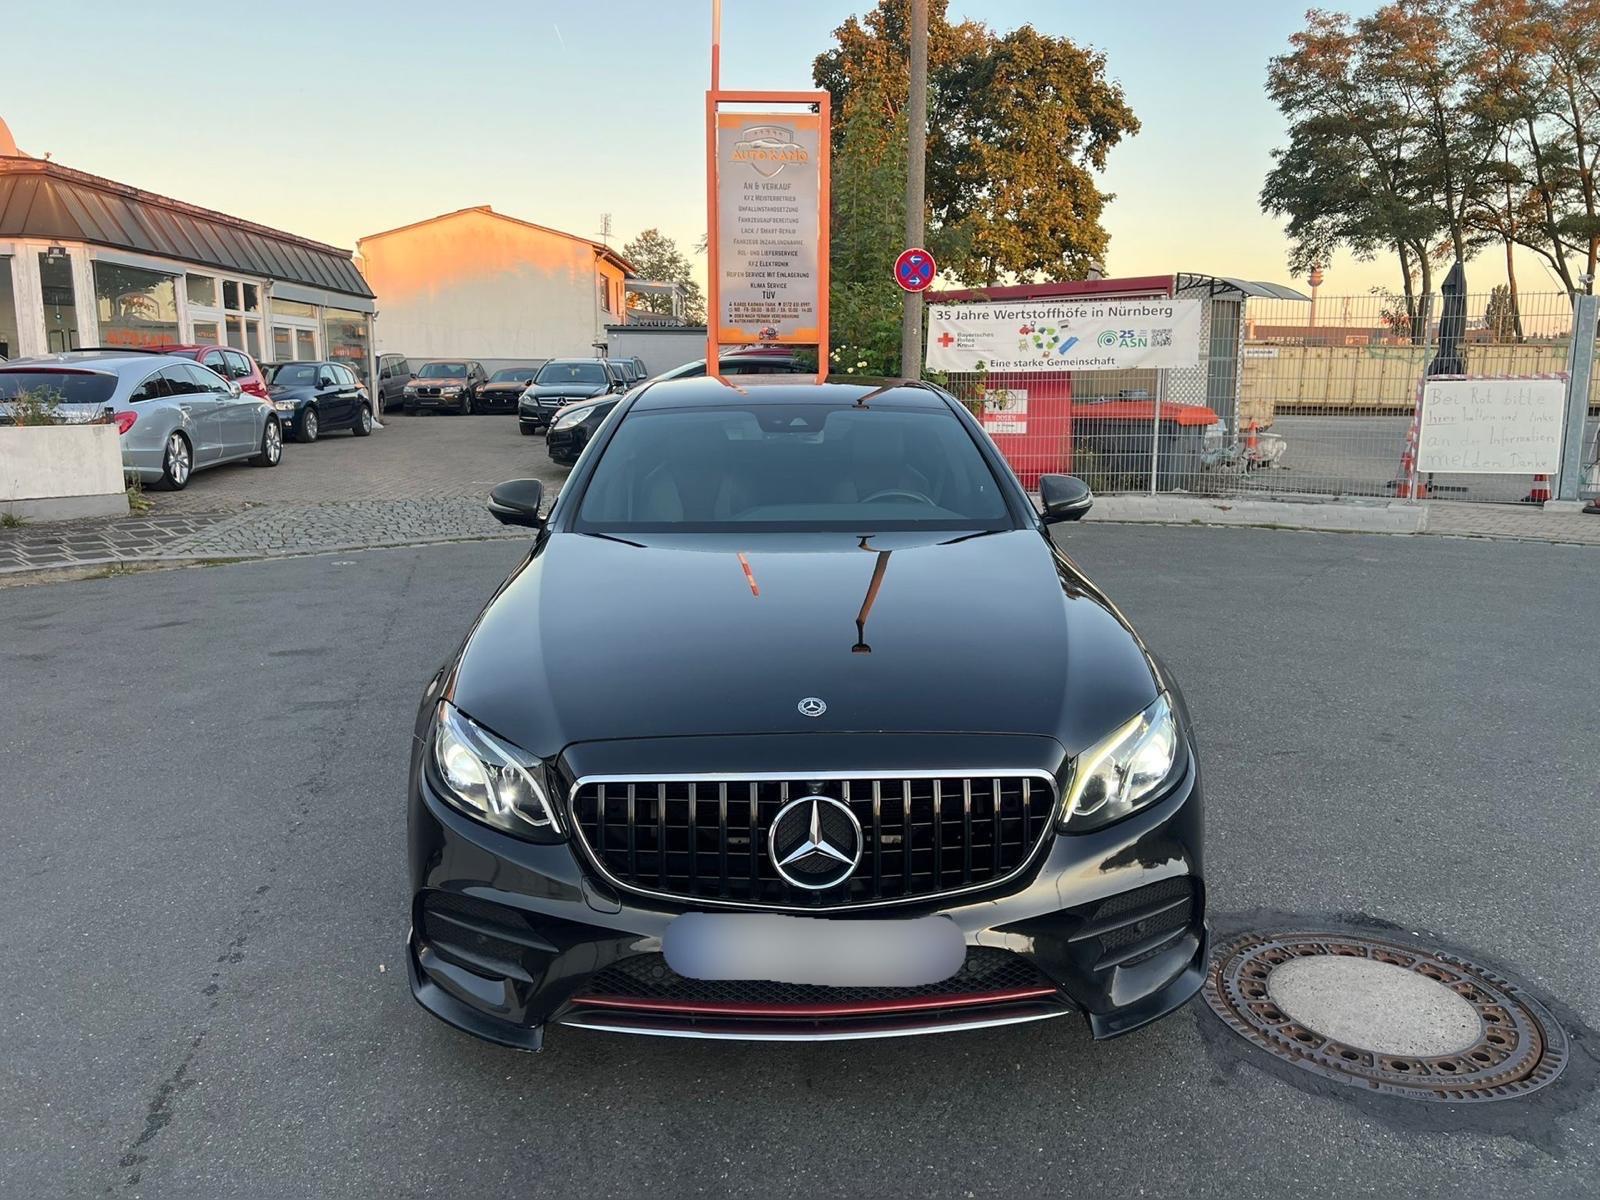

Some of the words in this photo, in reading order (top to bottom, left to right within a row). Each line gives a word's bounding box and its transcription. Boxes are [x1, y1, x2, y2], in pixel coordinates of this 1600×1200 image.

[743, 182, 754, 190] AN
[761, 182, 792, 191] VERKAUF
[755, 194, 796, 202] MEISTERBETRIEB
[738, 216, 799, 224] FAHRZEUGAUFBEREITUNG
[776, 271, 810, 279] EINLAGERUNG
[936, 310, 951, 320] 35
[955, 310, 990, 320] Jahre
[993, 307, 1087, 320] Wertstoffhöfe
[1091, 307, 1104, 317] in
[1108, 306, 1173, 318] Nürnberg
[1119, 330, 1135, 338] 25
[1119, 338, 1147, 348] ASN
[990, 359, 1010, 367] Eine
[1013, 359, 1044, 367] starke
[1047, 357, 1115, 367] Gemeinschaft
[1430, 388, 1459, 406] Bei
[1471, 387, 1492, 405] Rot
[1504, 387, 1546, 406] bitte
